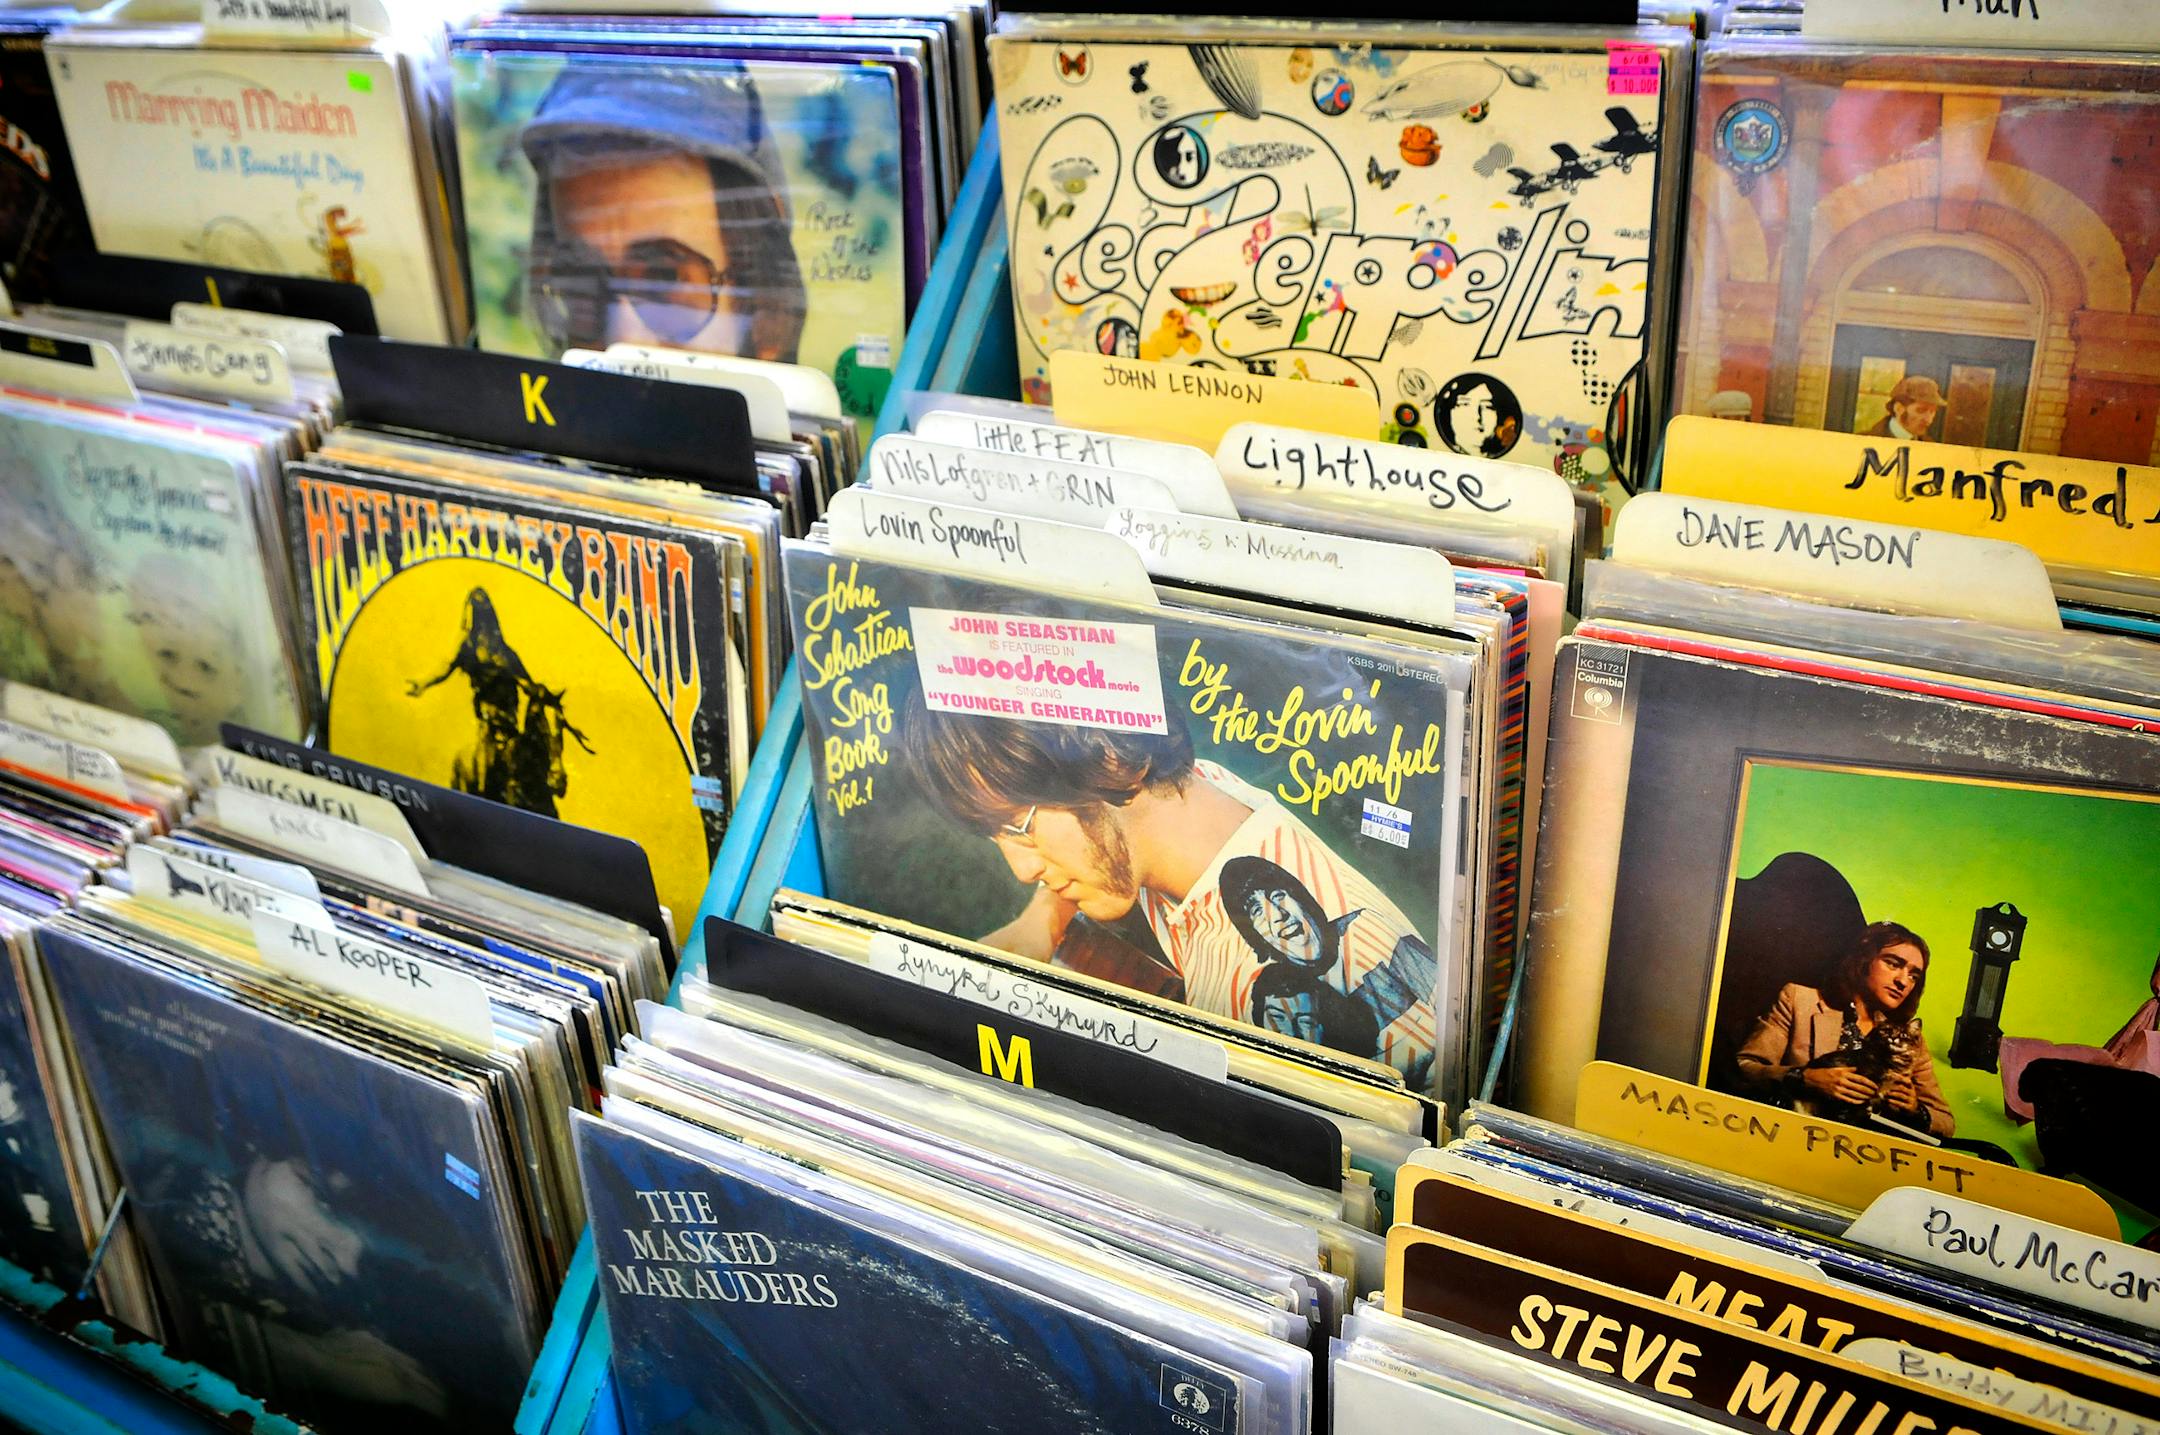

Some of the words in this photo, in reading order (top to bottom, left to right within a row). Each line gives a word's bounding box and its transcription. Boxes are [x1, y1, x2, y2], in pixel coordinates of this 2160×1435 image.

[104, 79, 241, 142] Marrying
[240, 86, 357, 138] Maiden
[520, 372, 557, 428] K
[1102, 363, 1157, 392] JOHN
[1168, 373, 1264, 405] LENNON
[1031, 428, 1117, 468] FEAT
[1243, 434, 1512, 513] Lighthouse
[1046, 471, 1115, 508] GRIN
[1844, 445, 2135, 530] Manfred
[860, 496, 926, 546] Lovin
[930, 505, 1030, 566] Spoonful
[1676, 506, 1765, 550] DAVE
[1773, 520, 1922, 569] MASON
[804, 561, 882, 634] John
[393, 492, 578, 602] HARTLEY
[575, 524, 702, 778] BAND
[802, 610, 915, 691] Sebastian
[948, 616, 1000, 636] JOHN
[1004, 620, 1117, 646] SEBASTIAN
[989, 639, 1002, 651] IS
[1001, 640, 1061, 656] FEATURED
[1062, 645, 1075, 657] IN
[936, 663, 954, 676] the
[952, 654, 1107, 690] woodstock
[1107, 680, 1141, 693] movie
[1178, 637, 1233, 715] by
[1346, 655, 1375, 670] KSBS
[1577, 671, 1624, 689] Columbia
[1580, 658, 1596, 669] KC
[1596, 661, 1624, 674] 31721
[830, 675, 895, 736] Song
[1015, 684, 1063, 700] SINGING
[1208, 691, 1259, 745] the
[824, 726, 889, 784] Book
[1277, 722, 1442, 816] Spoonful
[288, 922, 329, 957] AL
[977, 1023, 1036, 1089] M
[1620, 1081, 1780, 1144] MASON
[1802, 1124, 1976, 1193] PROFIT
[635, 1190, 718, 1224] THE
[623, 1229, 778, 1267] MASKED
[1923, 1205, 2006, 1269] Paul
[607, 1264, 839, 1309] MARAUDERS
[1664, 1270, 1856, 1354] MEAT
[1510, 1294, 1703, 1400] STEVE
[1898, 1348, 2016, 1407] Buddy
